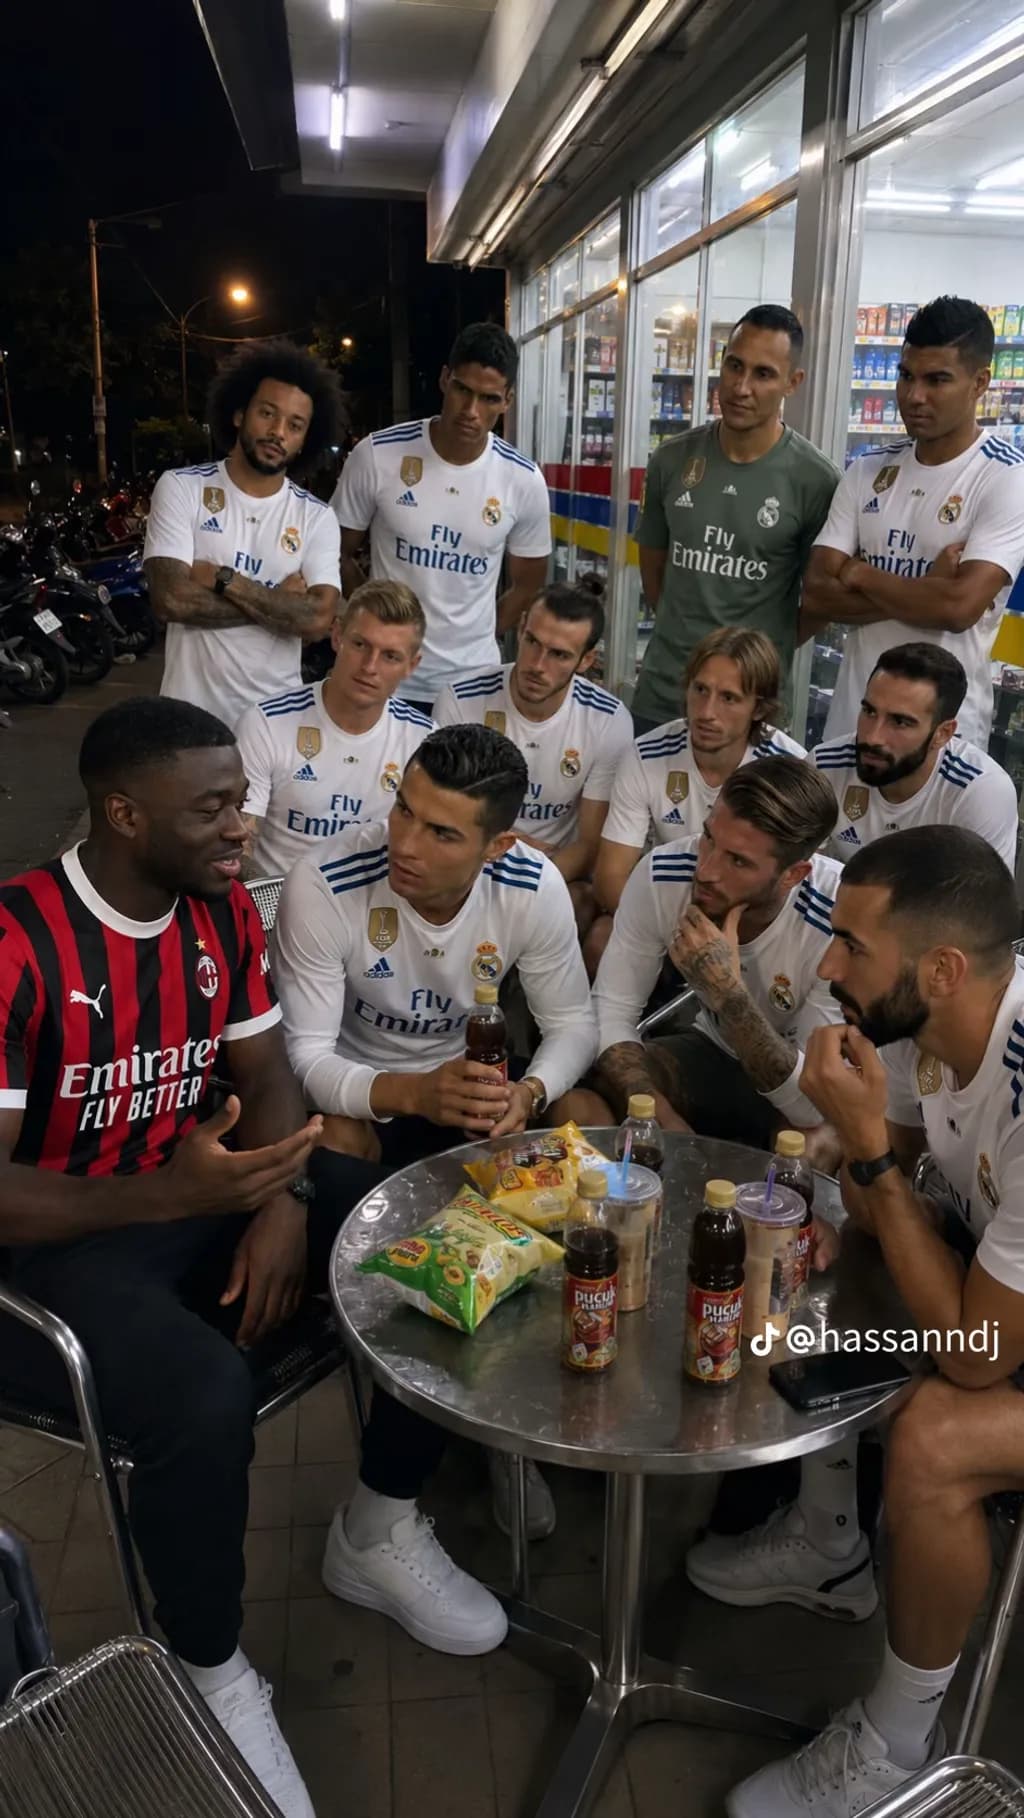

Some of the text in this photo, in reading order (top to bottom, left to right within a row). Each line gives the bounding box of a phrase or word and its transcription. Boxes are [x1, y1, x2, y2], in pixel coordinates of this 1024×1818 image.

[431, 524, 462, 548] Fly
[705, 525, 735, 550] Fly
[888, 529, 916, 553] Fly
[234, 551, 263, 575] Fly
[396, 537, 488, 575] Emirates
[672, 541, 768, 581] Emirates
[330, 794, 362, 816] Fly
[520, 801, 572, 820] rates
[411, 989, 452, 1013] Fly
[79, 1076, 202, 1131] FLY BETTER
